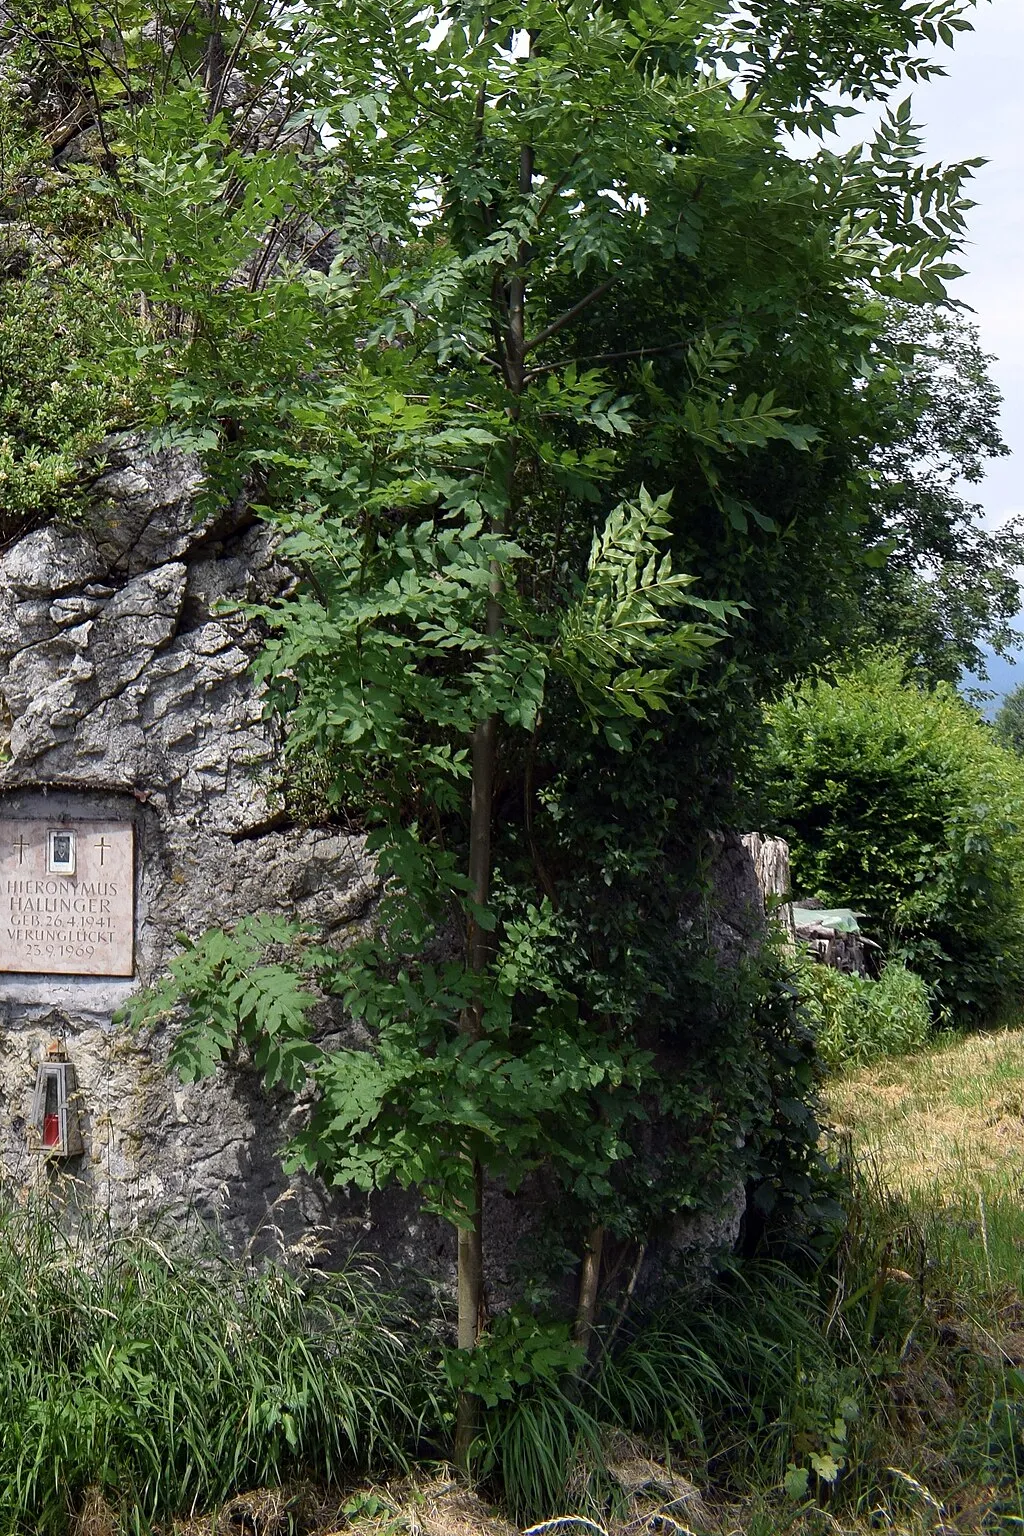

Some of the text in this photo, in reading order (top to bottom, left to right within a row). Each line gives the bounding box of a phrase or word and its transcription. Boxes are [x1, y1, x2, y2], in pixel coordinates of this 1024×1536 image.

[7, 880, 118, 896] HIERONYMUS
[10, 897, 111, 913] HALLINGER
[10, 914, 43, 927] GEB.
[7, 928, 115, 943] VERUNGLÜCKT
